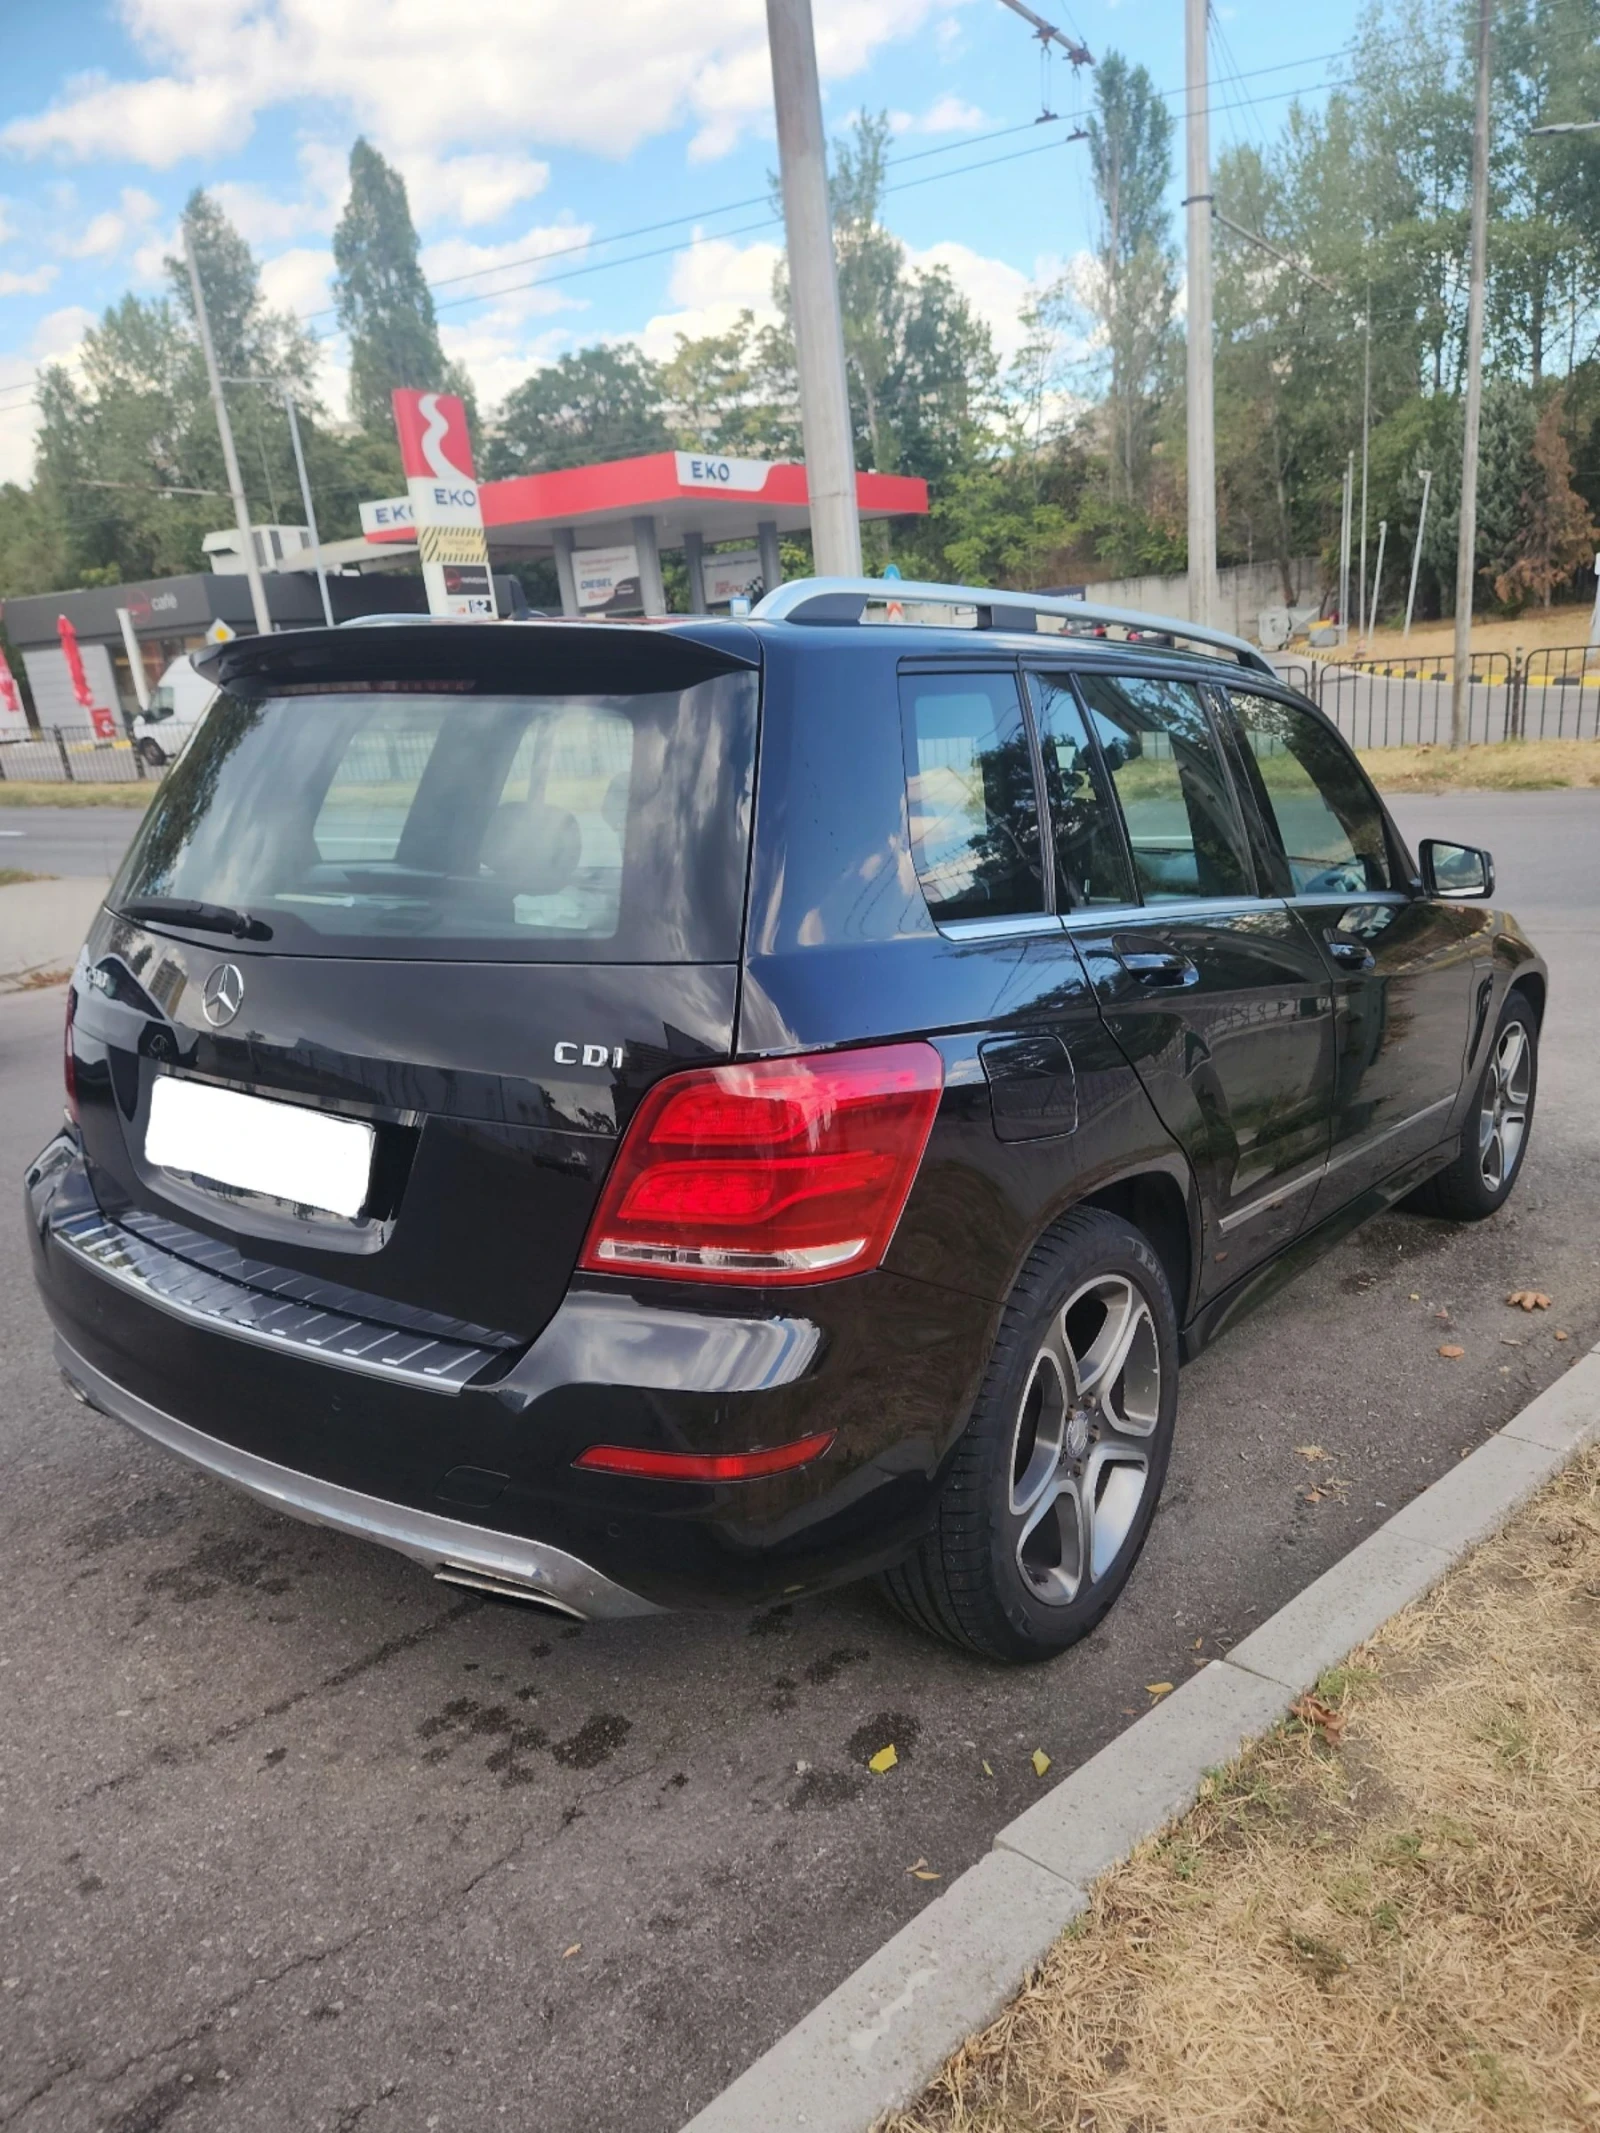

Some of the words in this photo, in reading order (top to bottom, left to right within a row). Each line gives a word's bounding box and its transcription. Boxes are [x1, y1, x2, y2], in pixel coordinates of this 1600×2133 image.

[691, 460, 730, 481] EKO
[433, 487, 477, 508] EKO
[553, 1041, 624, 1069] CDI
